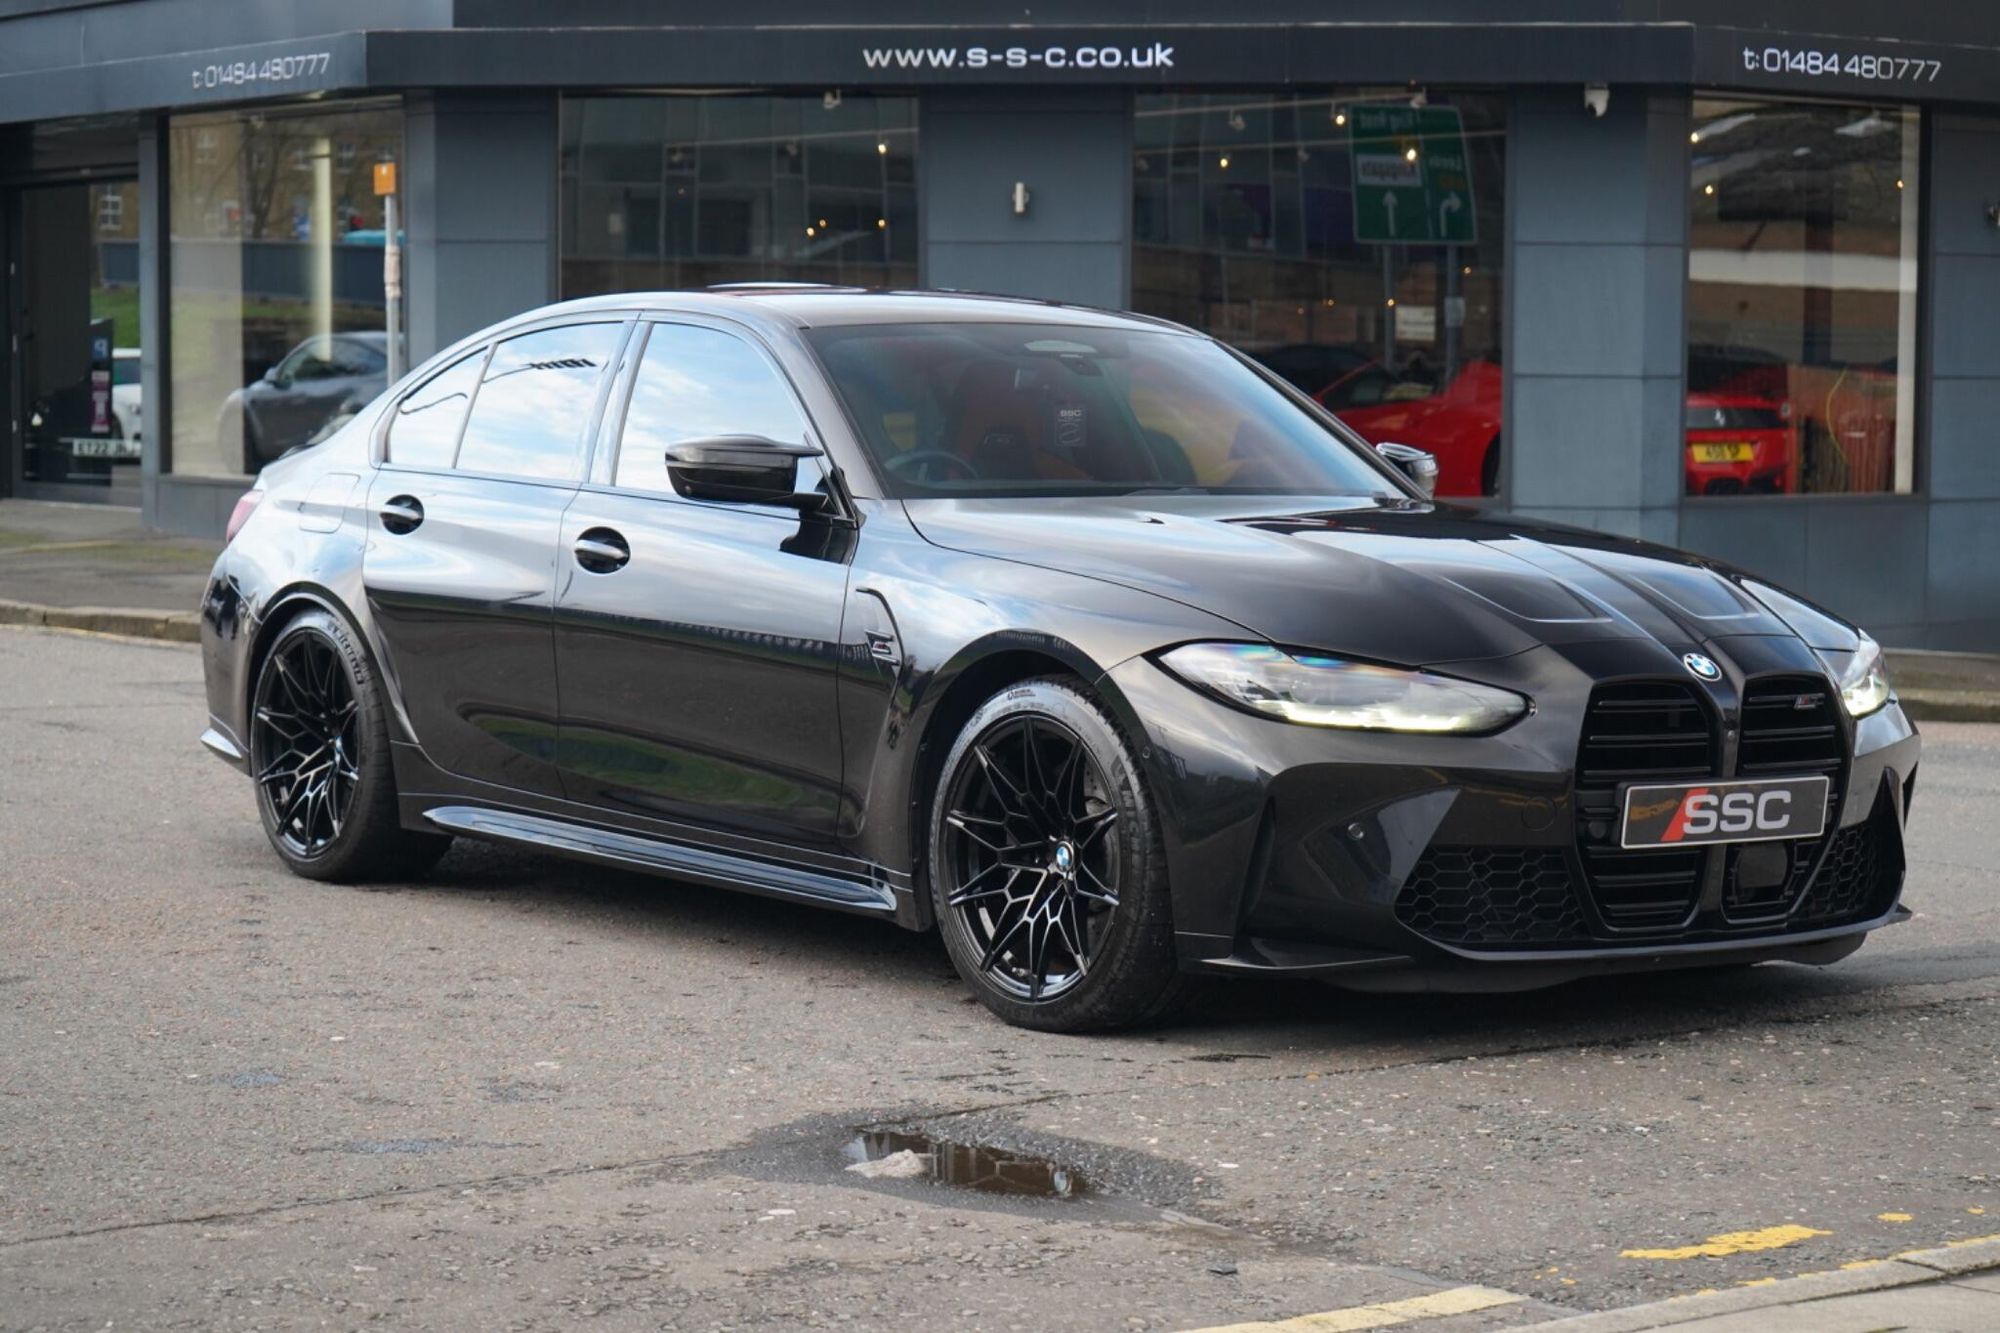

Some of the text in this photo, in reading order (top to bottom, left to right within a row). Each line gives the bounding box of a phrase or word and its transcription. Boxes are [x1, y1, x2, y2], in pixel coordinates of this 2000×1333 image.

[259, 52, 331, 81] 480777
[862, 42, 1174, 68] www.s-s-c.co.uk
[1844, 54, 1942, 82] 480777
[1682, 790, 1792, 835] SSC
